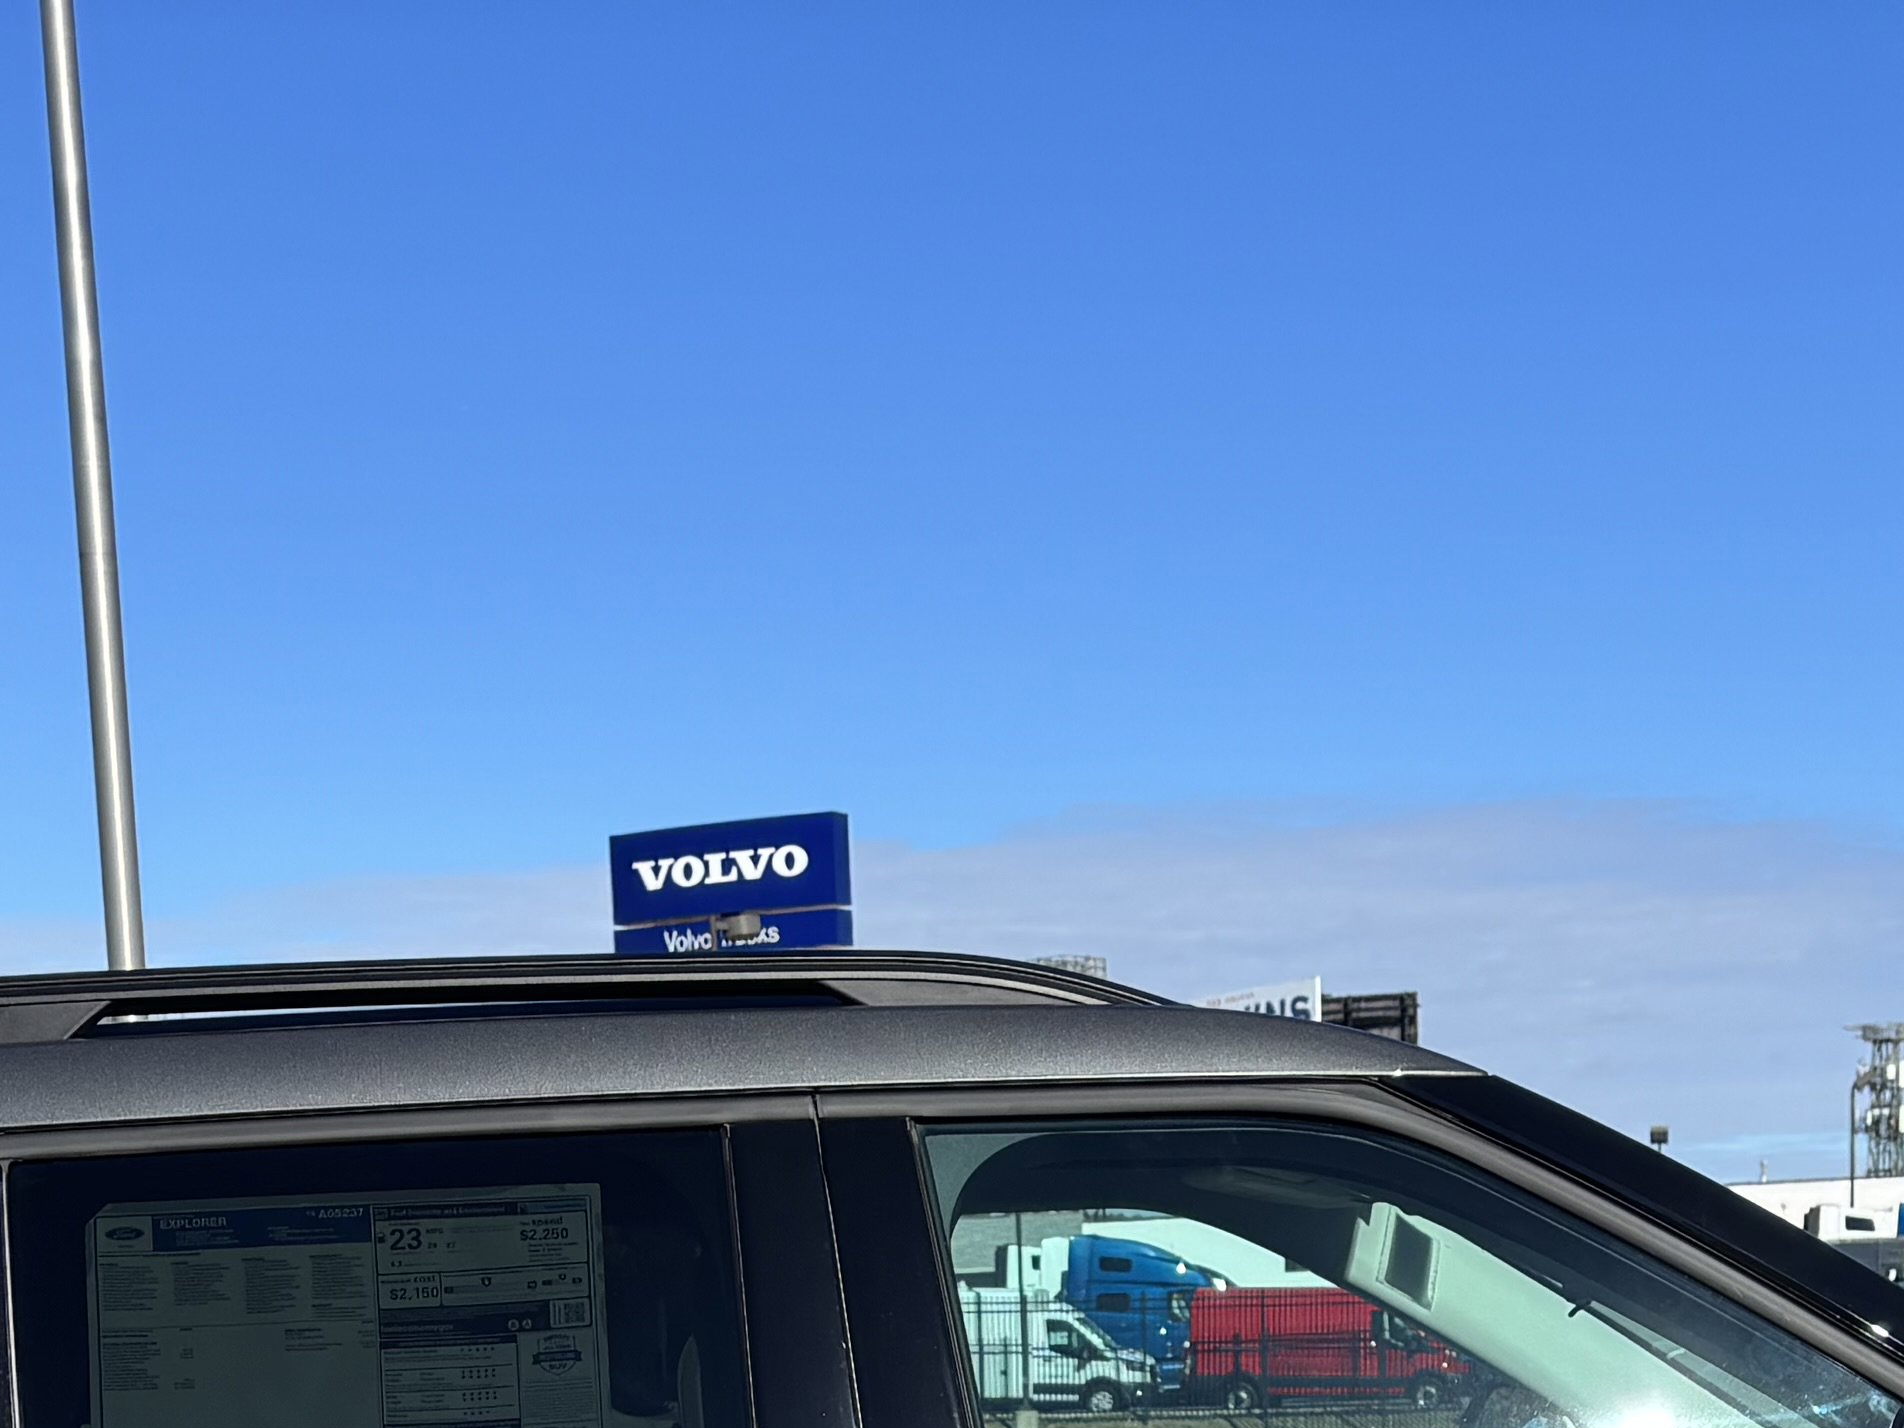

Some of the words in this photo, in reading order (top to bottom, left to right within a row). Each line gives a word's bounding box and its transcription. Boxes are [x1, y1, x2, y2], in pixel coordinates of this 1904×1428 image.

[631, 844, 810, 892] VOLVO
[663, 927, 712, 953] Volvo
[159, 1215, 227, 1229] EXPLORER
[389, 1228, 423, 1251] 23
